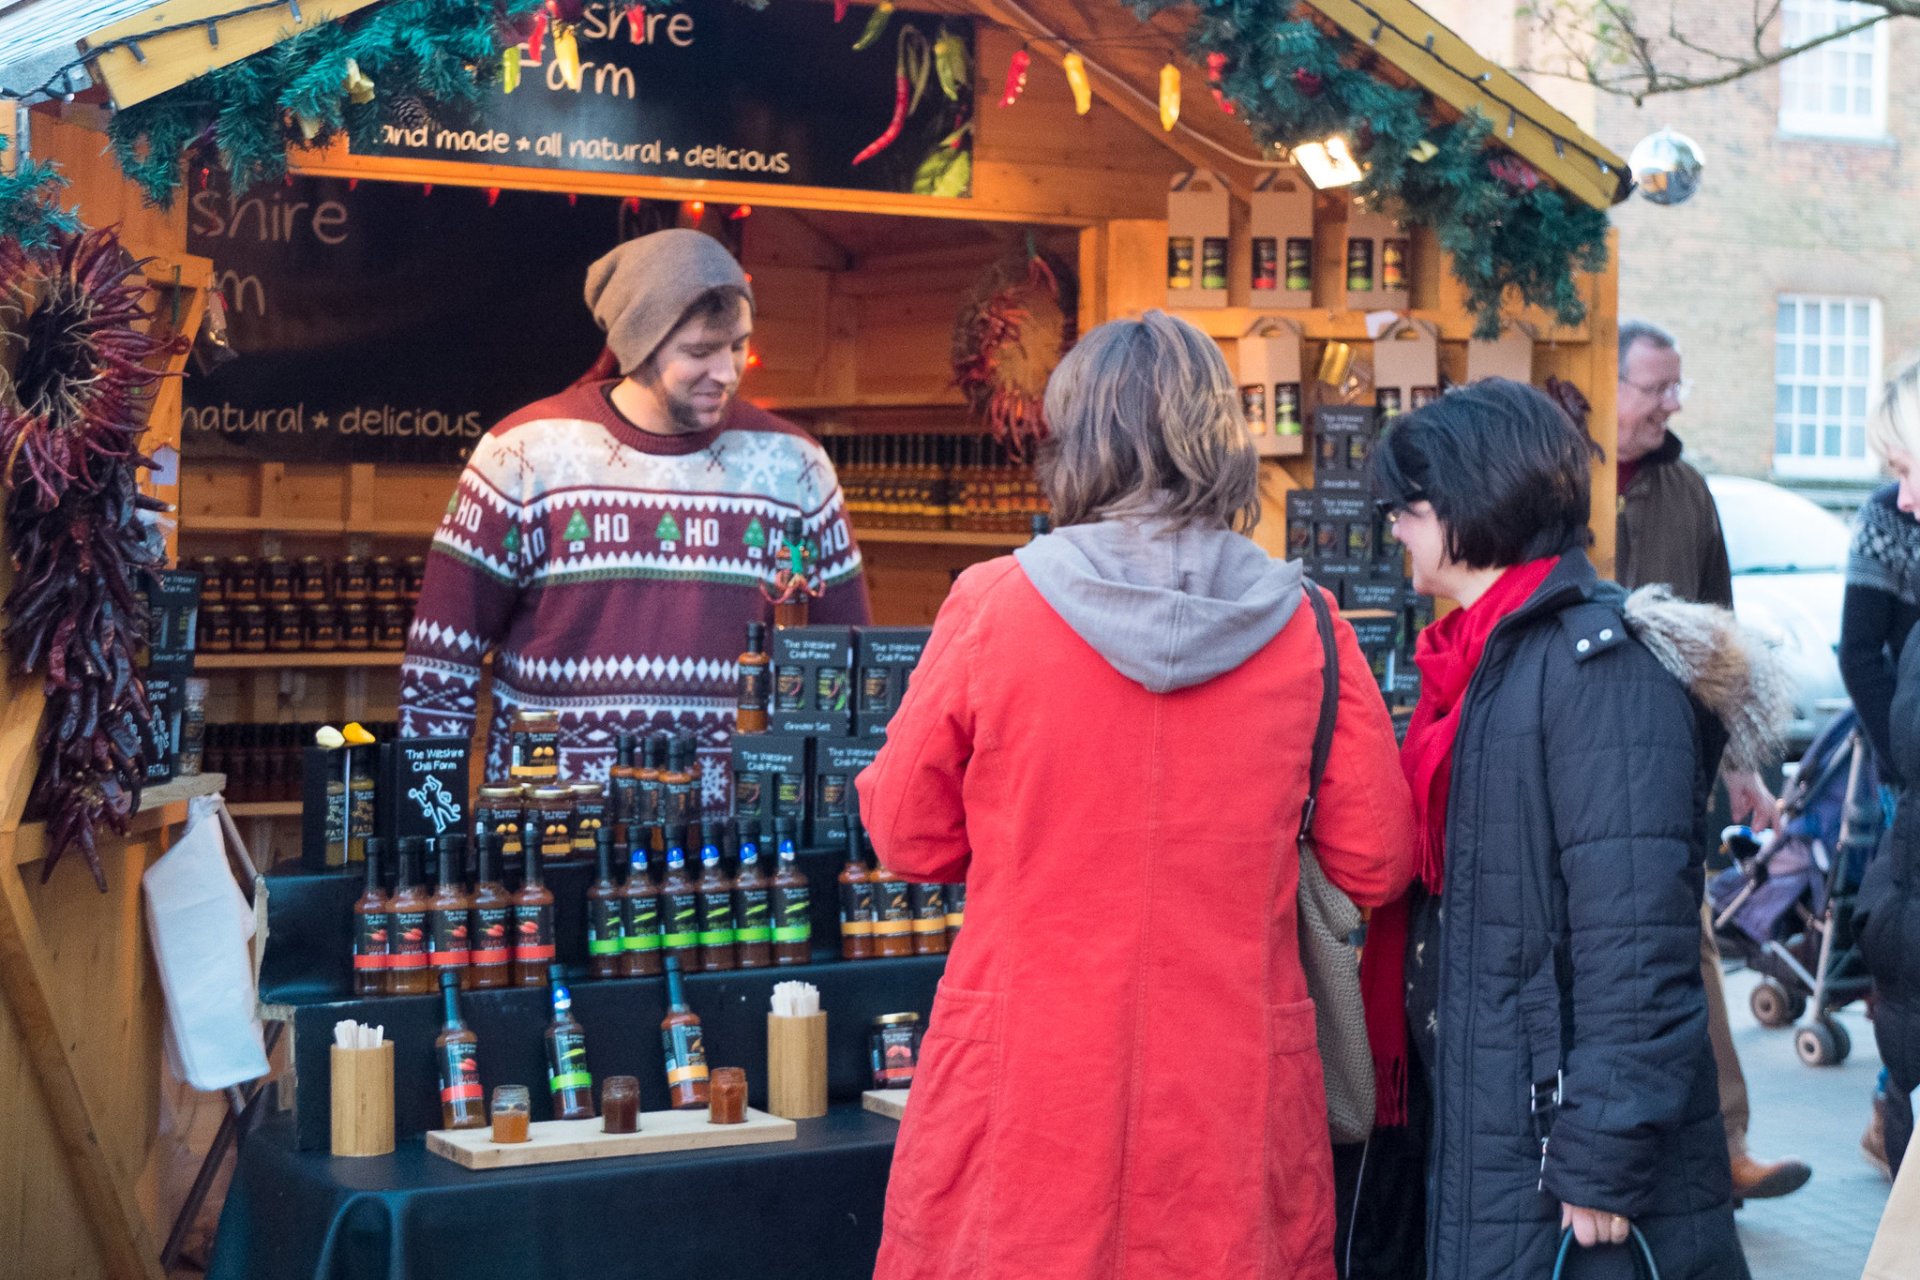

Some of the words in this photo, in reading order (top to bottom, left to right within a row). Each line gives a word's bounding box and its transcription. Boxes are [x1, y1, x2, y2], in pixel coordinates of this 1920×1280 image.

[583, 2, 695, 47] shre
[374, 124, 429, 148] and
[436, 128, 510, 154] made
[535, 131, 563, 158] all
[568, 137, 662, 165] natural
[684, 145, 791, 174] delicious
[181, 402, 305, 434] natural
[338, 405, 483, 438] delicious
[455, 494, 484, 534] HO
[594, 513, 631, 543] HO
[685, 517, 721, 548] HO
[766, 527, 785, 557] H
[821, 518, 851, 560] HO
[406, 749, 424, 760] The
[427, 748, 465, 759] Wiltshire
[433, 760, 457, 771] Farm
